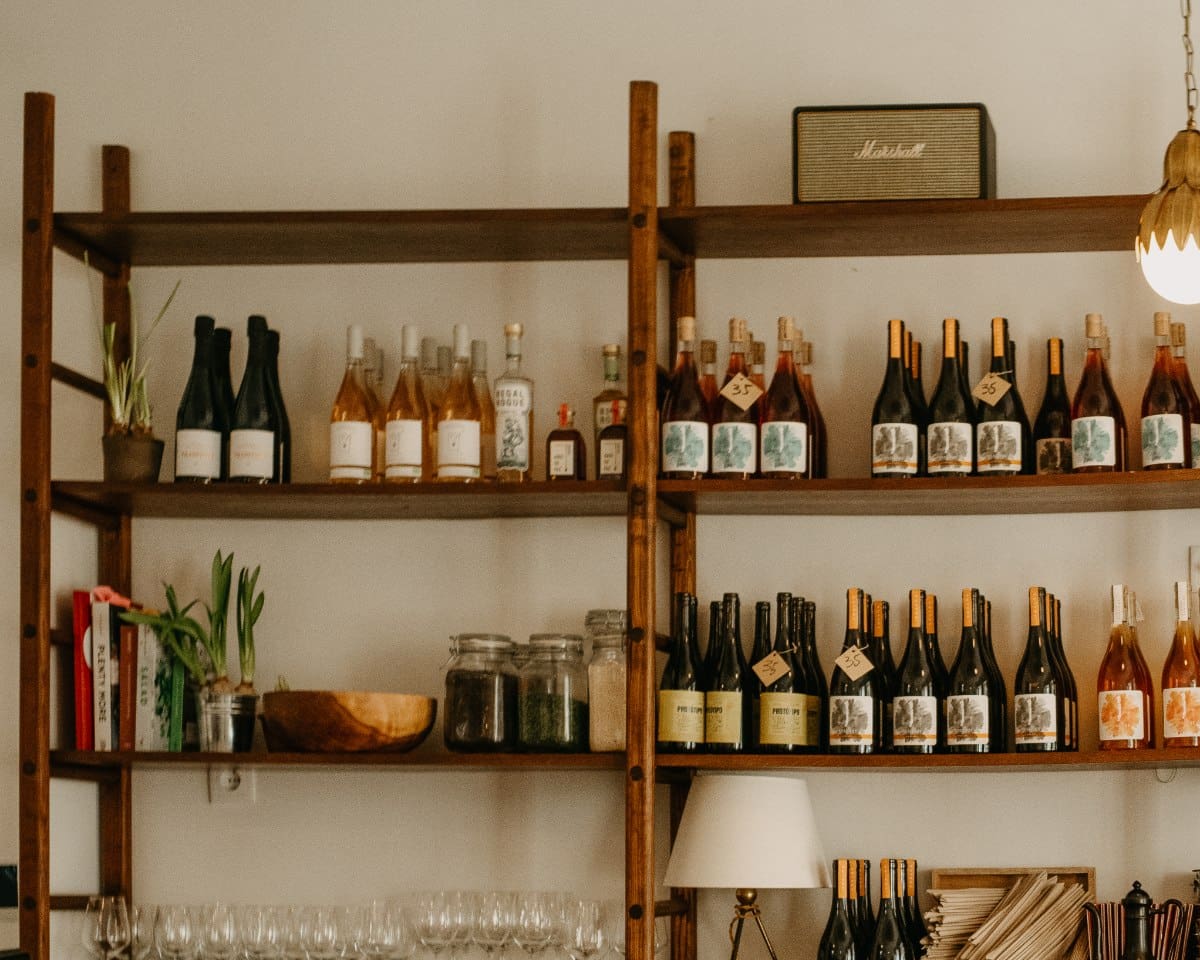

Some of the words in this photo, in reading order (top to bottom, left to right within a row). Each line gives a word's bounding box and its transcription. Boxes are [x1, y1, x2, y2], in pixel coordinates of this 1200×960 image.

[854, 140, 926, 159] Marshall
[731, 384, 753, 396] 35
[97, 645, 106, 686] PLENTY
[98, 690, 107, 722] MORE
